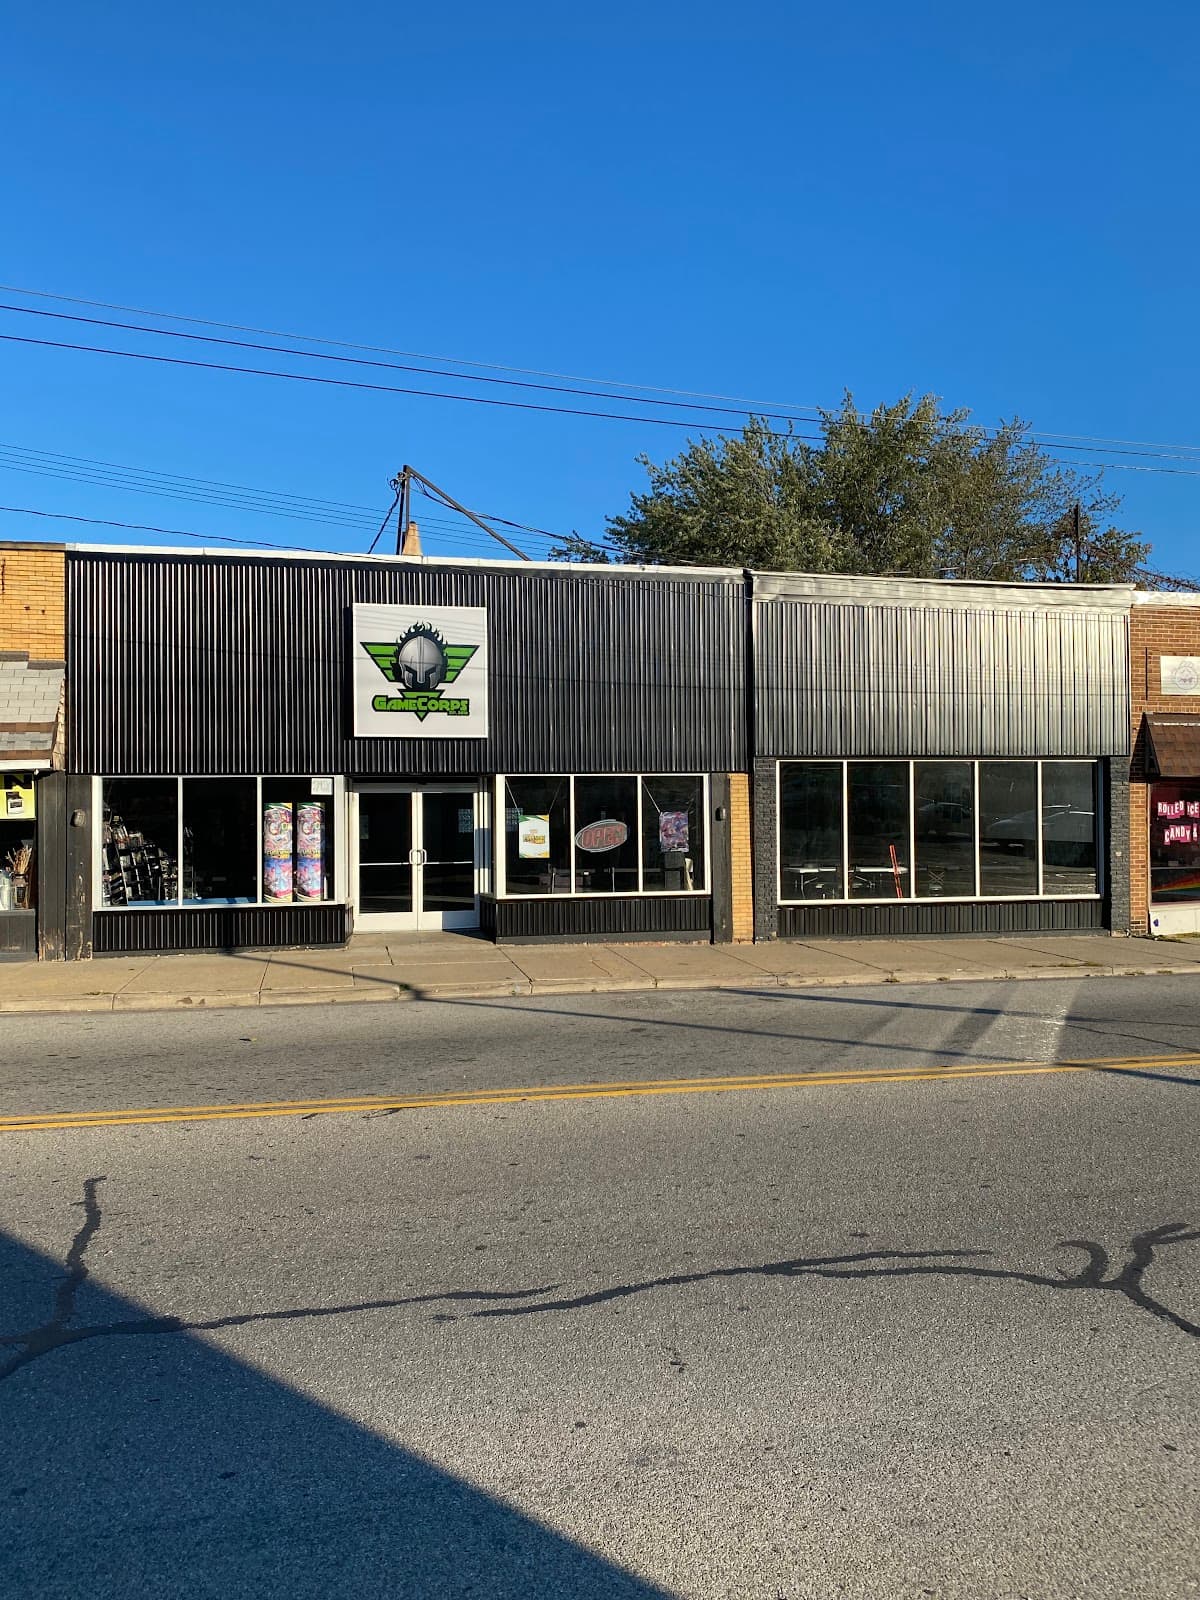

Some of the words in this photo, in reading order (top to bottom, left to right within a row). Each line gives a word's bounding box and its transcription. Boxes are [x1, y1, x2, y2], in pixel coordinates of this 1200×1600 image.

[1157, 801, 1185, 816] ROLLED
[1187, 802, 1199, 815] ICE
[581, 825, 625, 848] OPEN
[1164, 826, 1190, 843] CANDY
